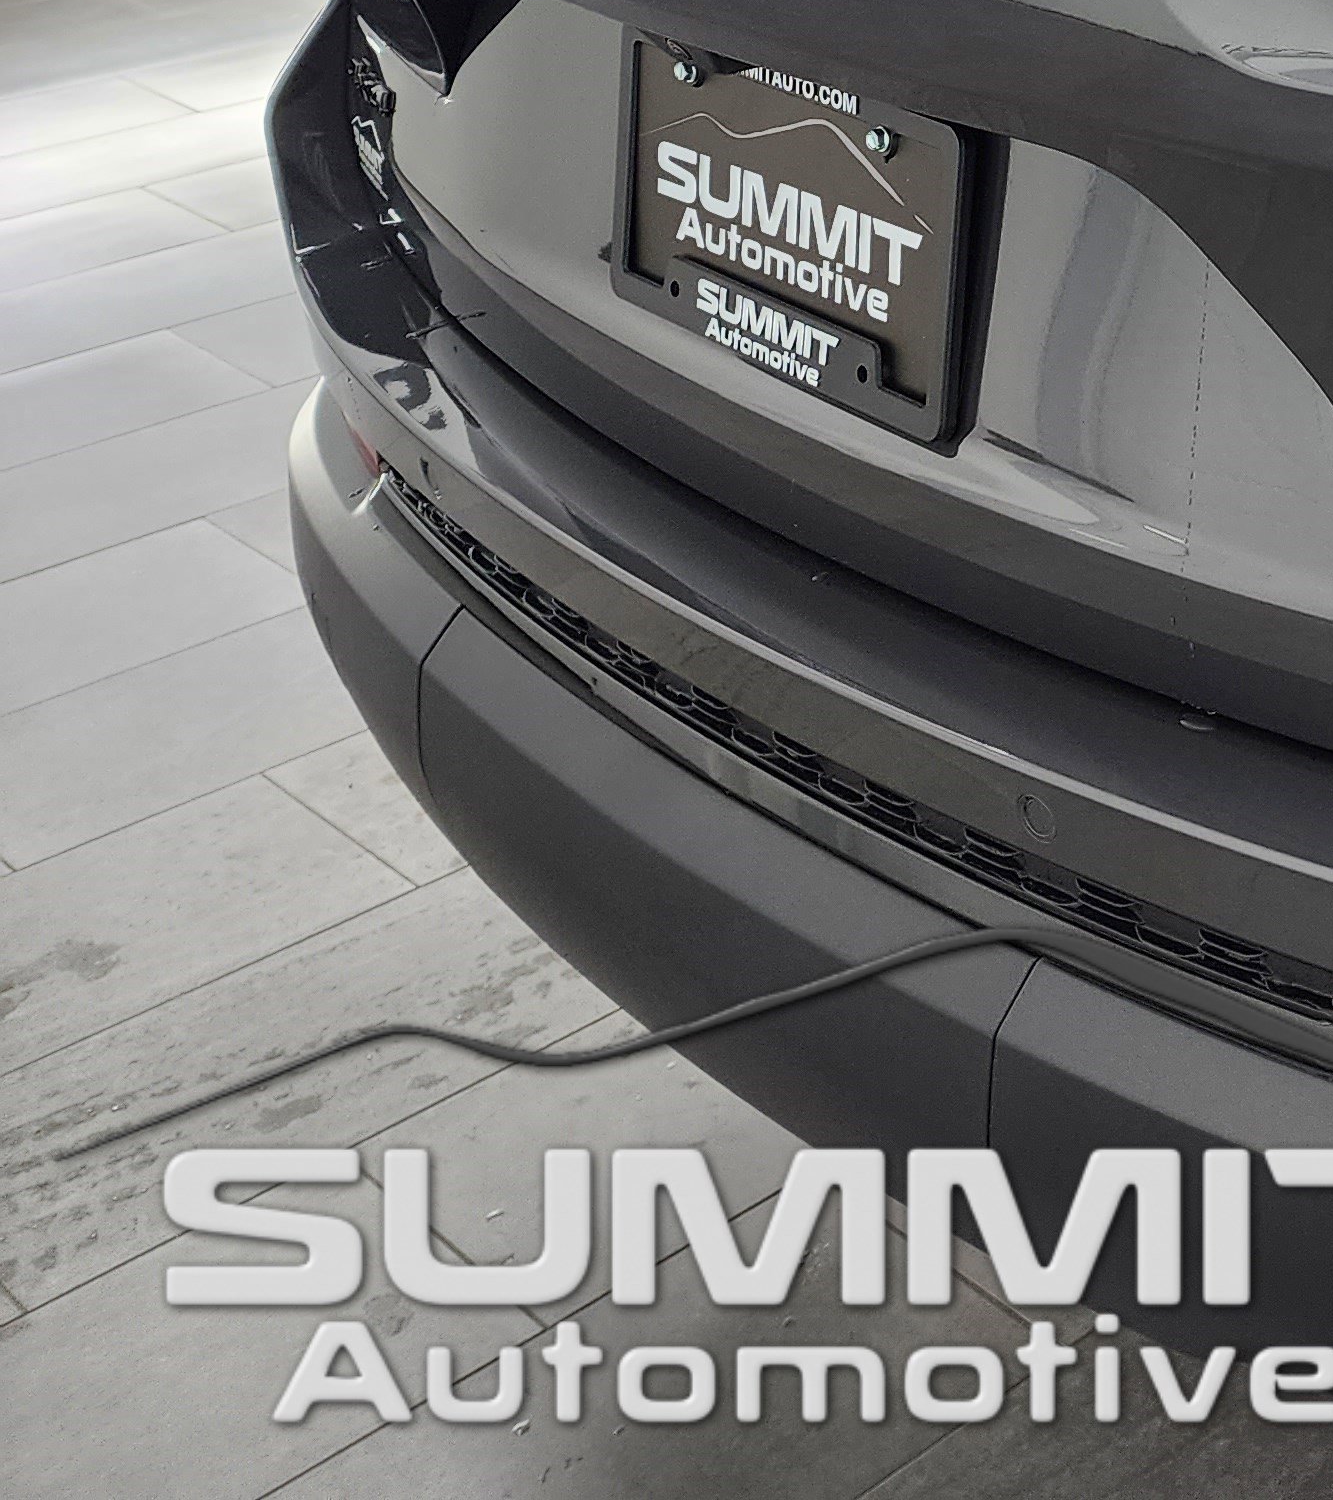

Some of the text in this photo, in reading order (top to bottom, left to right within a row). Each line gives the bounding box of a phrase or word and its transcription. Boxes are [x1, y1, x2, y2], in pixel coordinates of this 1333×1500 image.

[657, 140, 923, 286] SUMMIT
[675, 206, 889, 323] Automotive
[696, 277, 840, 367] SUMMIT
[704, 316, 820, 388] Automotive
